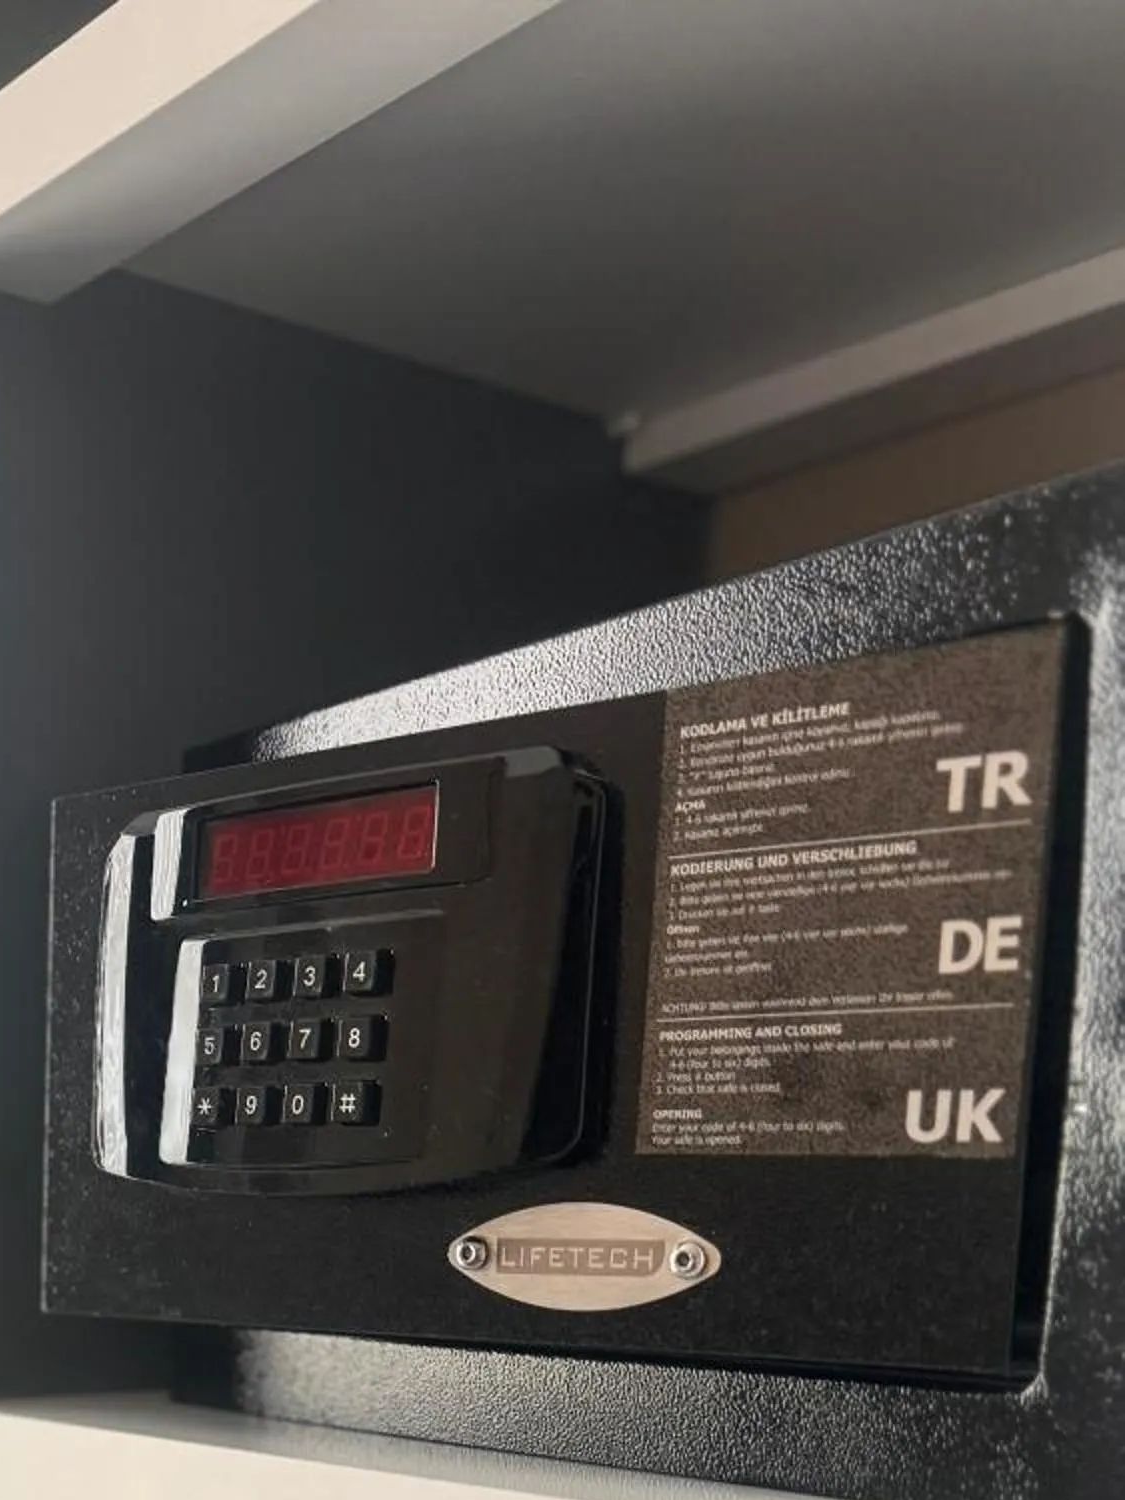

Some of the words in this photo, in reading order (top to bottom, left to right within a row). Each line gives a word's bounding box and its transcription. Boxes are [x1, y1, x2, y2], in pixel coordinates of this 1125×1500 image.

[680, 717, 747, 739] KODLAMA
[750, 713, 769, 729] VE
[772, 701, 850, 726] KİLİTLEME
[935, 749, 1033, 814] TR
[670, 857, 754, 877] KODIERUNG
[757, 853, 789, 869] UND
[938, 915, 1023, 975] DE
[212, 974, 220, 993] 1
[254, 968, 268, 989] 2
[303, 966, 316, 987] 3
[352, 961, 367, 982] 4
[204, 1037, 216, 1055] 5
[249, 1031, 262, 1051] 6
[298, 1028, 312, 1049] 7
[347, 1027, 361, 1048] 8
[658, 1026, 753, 1042] PROGRAMMING
[754, 1024, 782, 1039] AND
[784, 1022, 843, 1037] CLOSING
[245, 1095, 258, 1115] 9
[291, 1095, 305, 1115] 0
[338, 1093, 356, 1113] #
[652, 1108, 703, 1120] OPENING
[905, 1087, 1007, 1144] UK
[499, 1246, 654, 1270] LIFETECH
